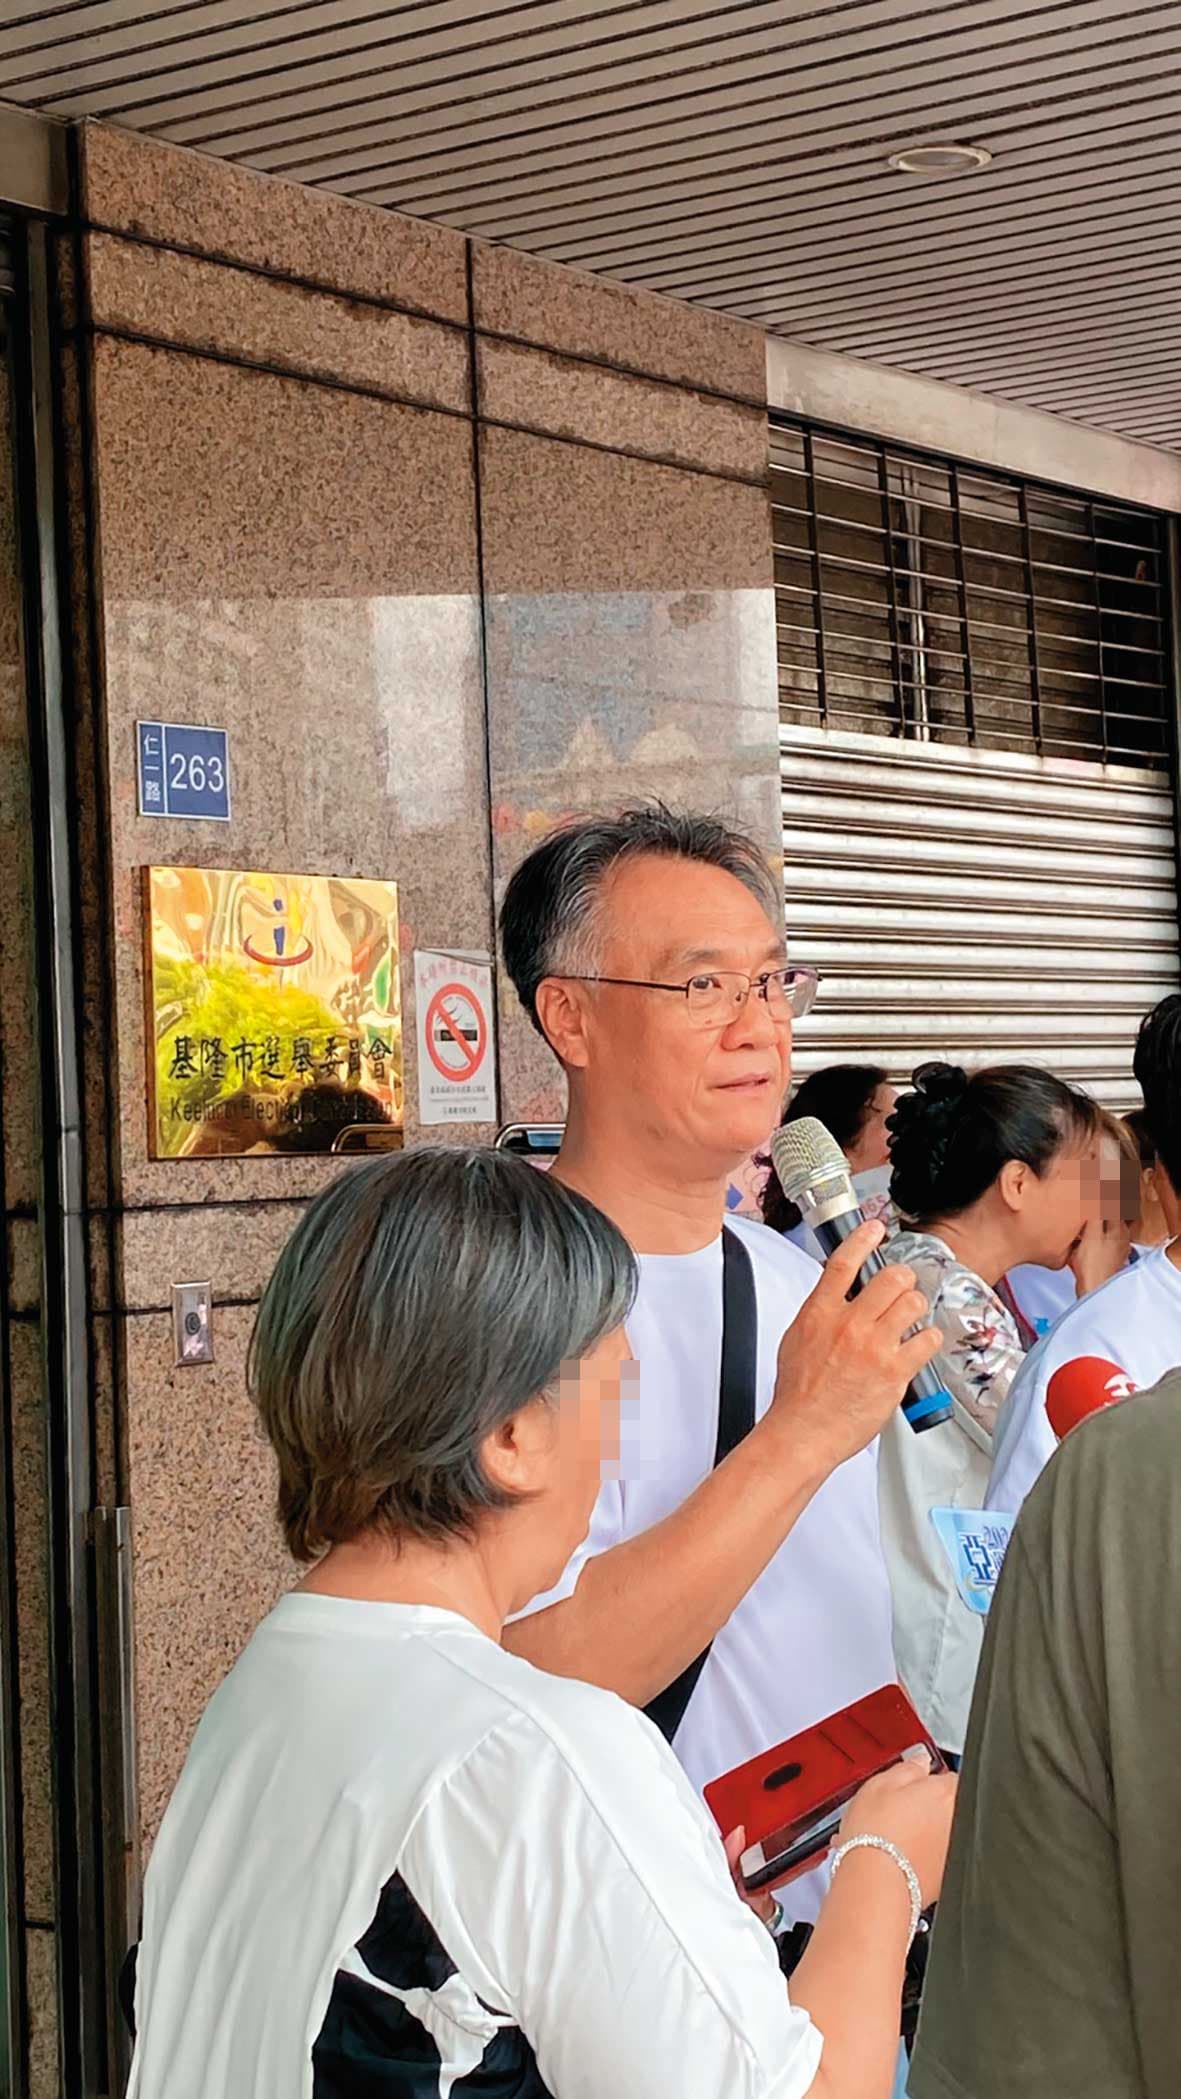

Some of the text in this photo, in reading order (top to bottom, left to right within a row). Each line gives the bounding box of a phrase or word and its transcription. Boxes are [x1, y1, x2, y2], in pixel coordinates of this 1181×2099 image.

[143, 734, 161, 802] 仁一路
[170, 753, 224, 792] 263
[168, 1035, 392, 1081] 基隆市選舉委員會
